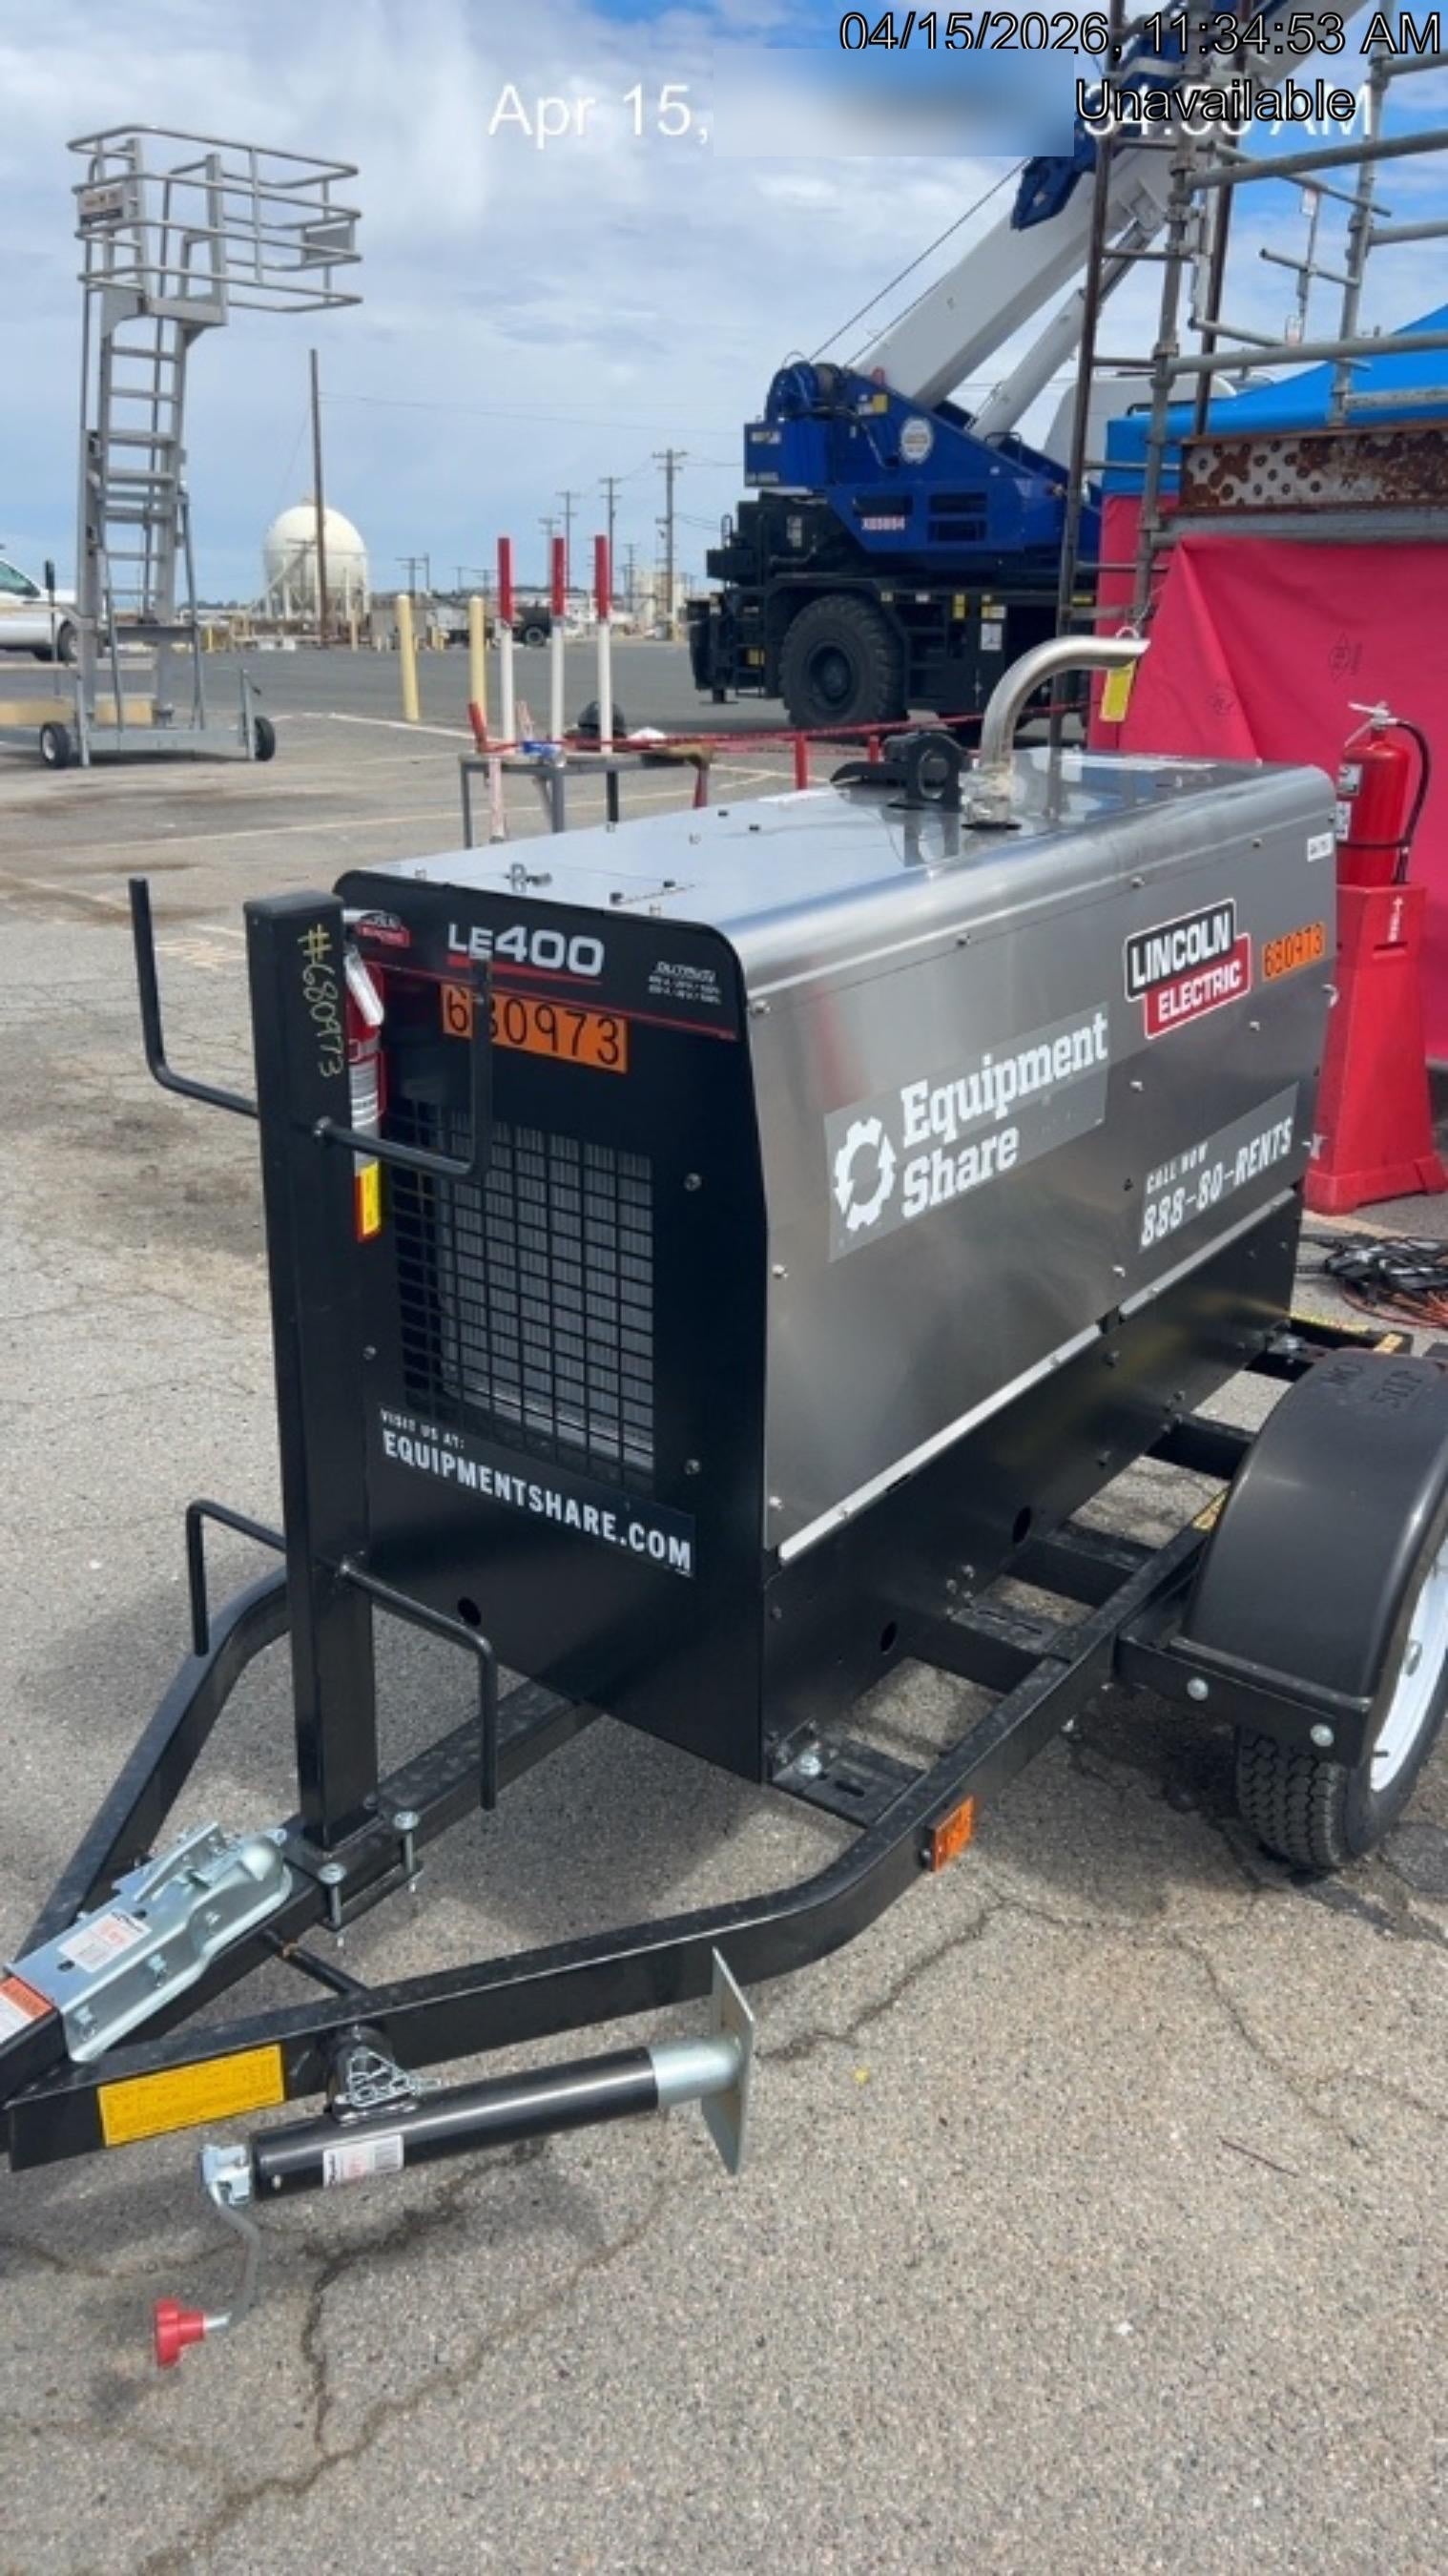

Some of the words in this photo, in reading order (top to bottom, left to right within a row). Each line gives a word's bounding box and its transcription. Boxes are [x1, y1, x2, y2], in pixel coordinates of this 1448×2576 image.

[447, 923, 605, 976] LE400
[1131, 910, 1231, 988] LINCOLN
[1264, 923, 1322, 977] 680973
[1157, 960, 1241, 1023] ELECTRIC
[900, 1011, 1107, 1147] Equipment
[901, 1126, 1020, 1218] Share
[1141, 1116, 1293, 1247] 888-80-RENTS
[1147, 1161, 1176, 1194] CALL
[383, 1428, 692, 1570] EQUIPMENTSHARE.COM
